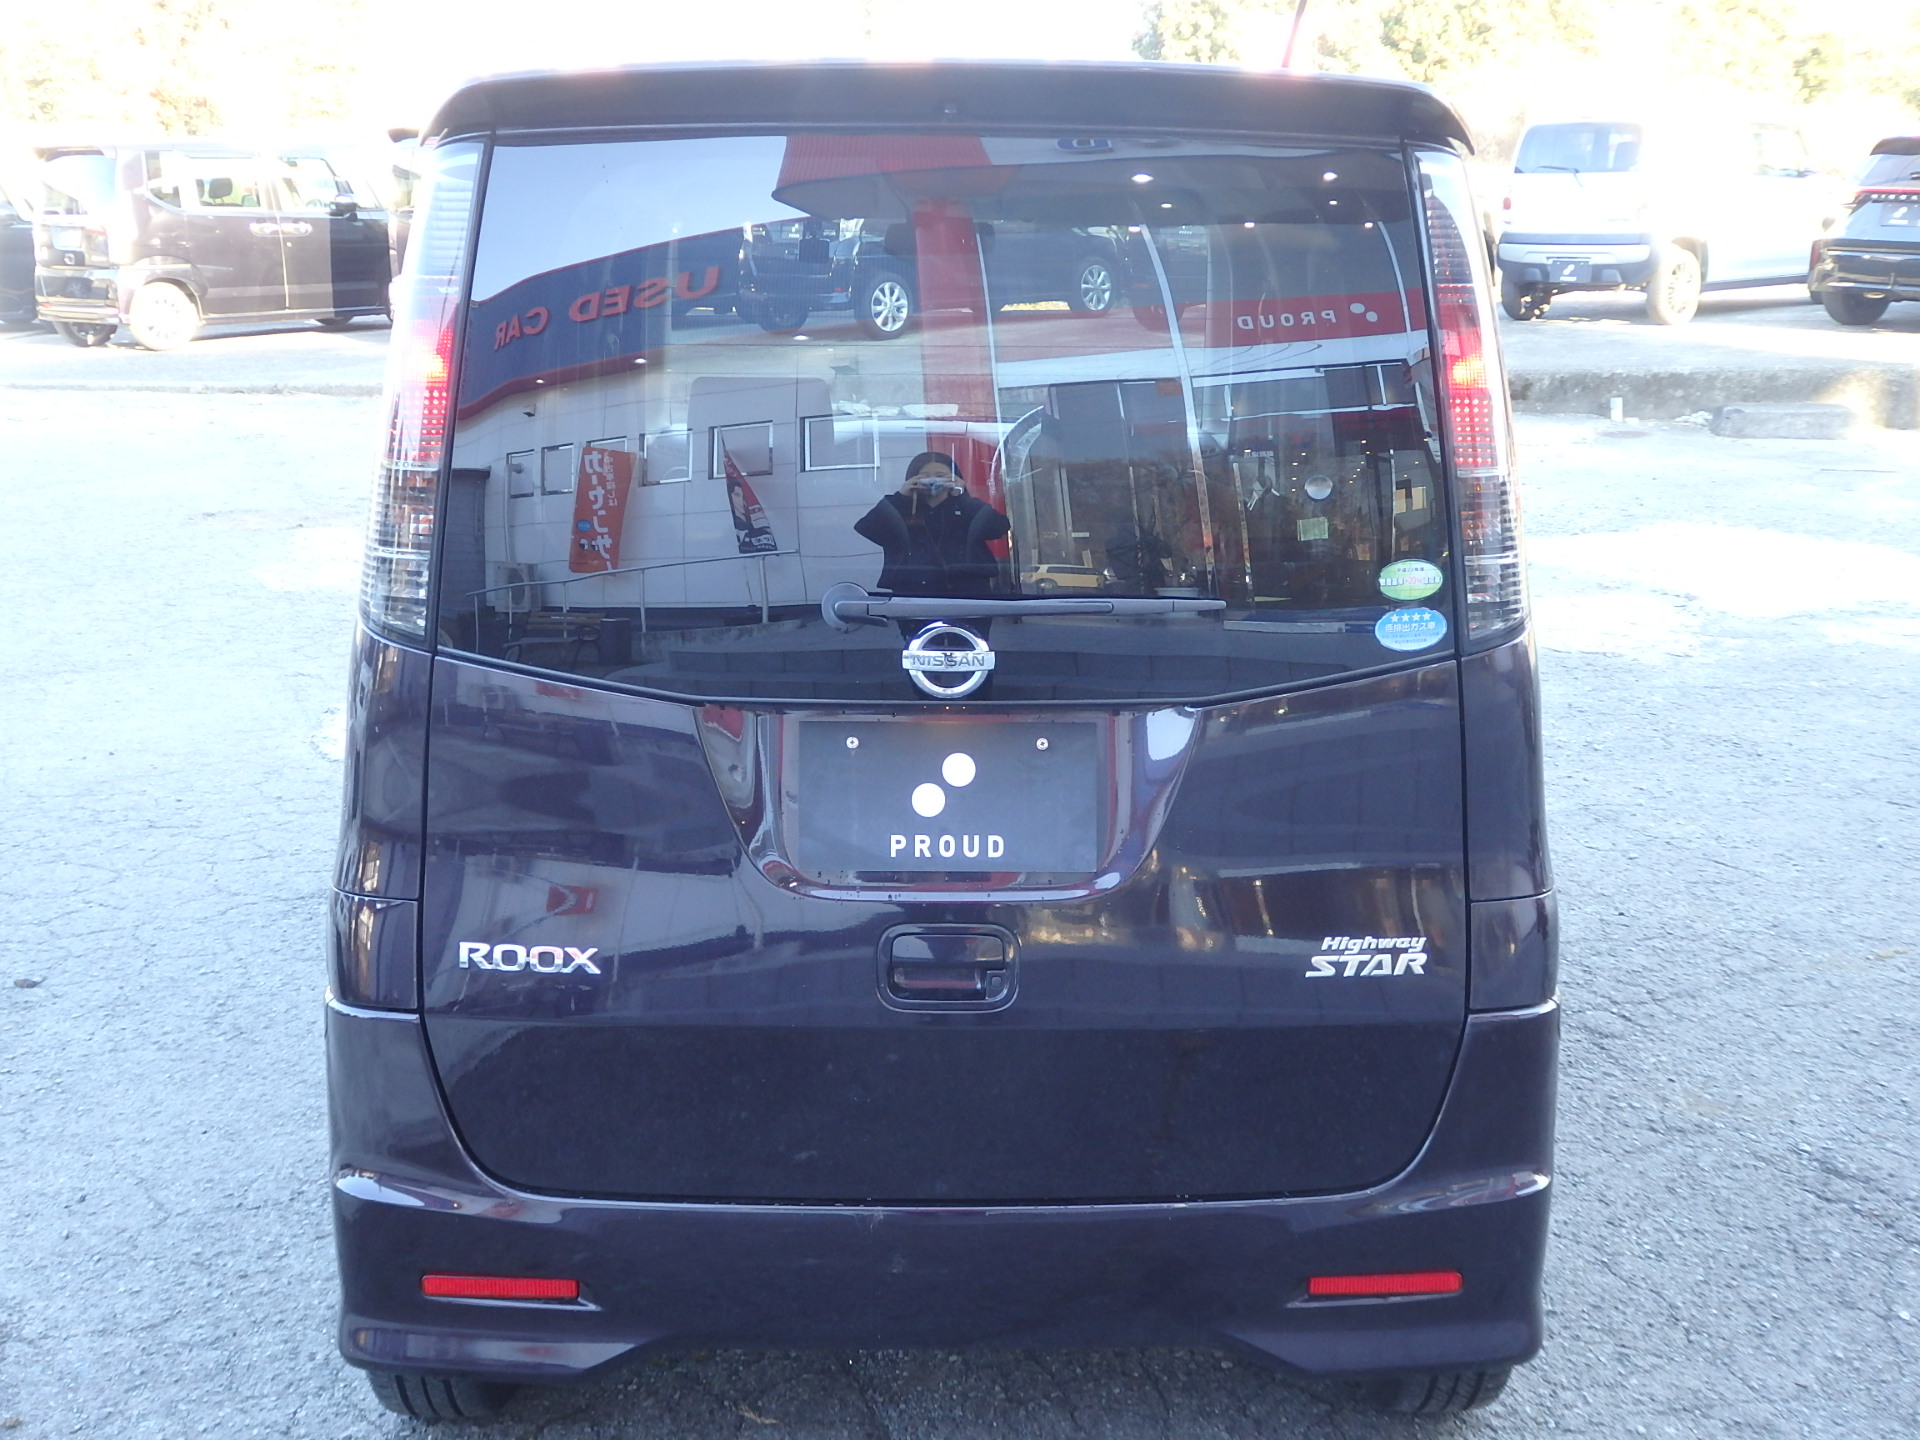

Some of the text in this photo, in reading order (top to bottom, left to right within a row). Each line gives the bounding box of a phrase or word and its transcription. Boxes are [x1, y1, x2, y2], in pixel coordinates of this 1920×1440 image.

[583, 450, 613, 572] カーセンサー
[1384, 621, 1436, 633] 低排出ガス車
[911, 654, 986, 668] NISSAN
[889, 834, 1005, 858] PROUD
[1321, 935, 1428, 955] Highway
[458, 941, 601, 974] ROOX
[1304, 952, 1428, 978] STAR
